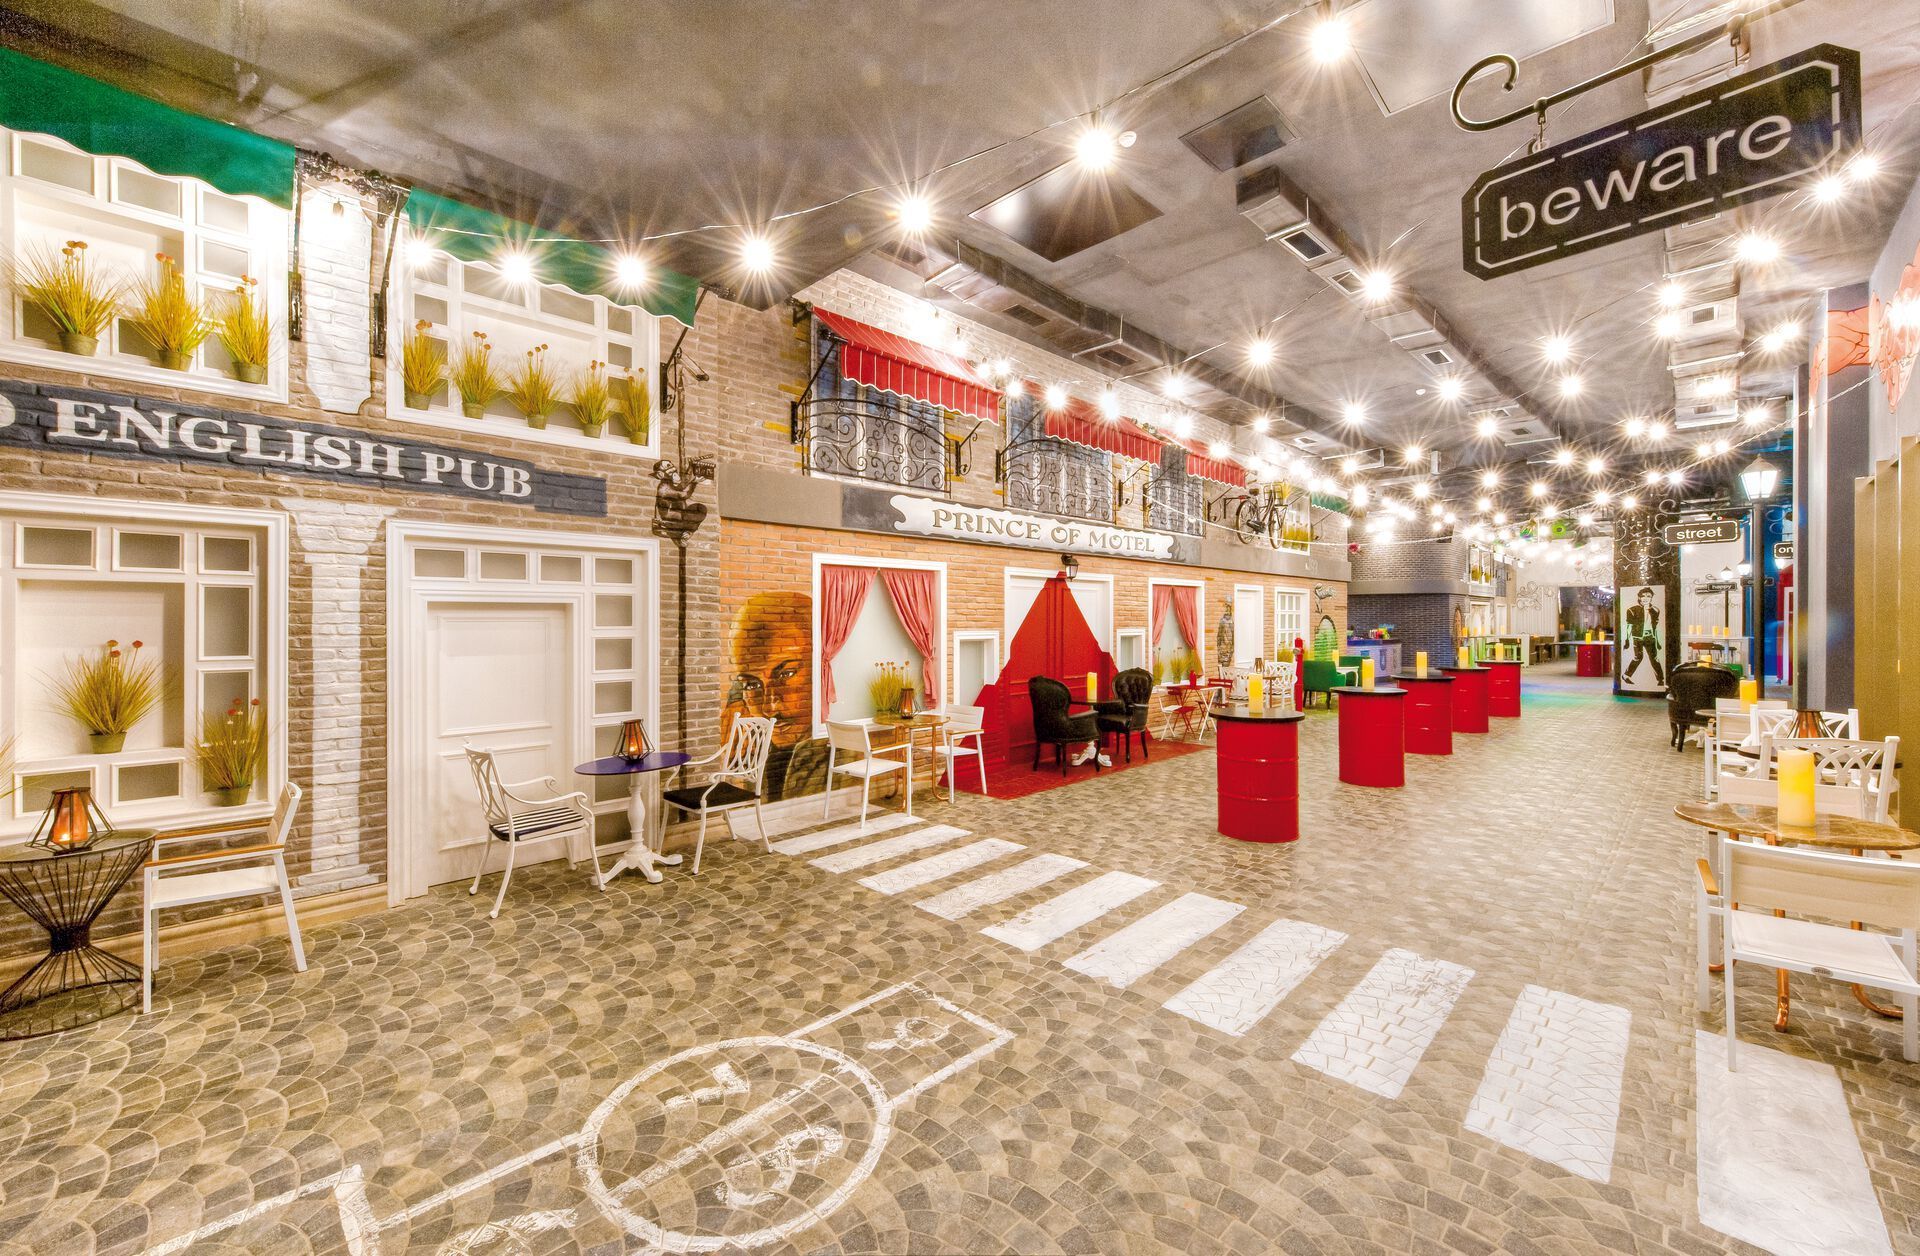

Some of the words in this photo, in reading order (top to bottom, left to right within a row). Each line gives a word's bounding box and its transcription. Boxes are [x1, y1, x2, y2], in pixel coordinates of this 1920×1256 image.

[1500, 115, 1792, 241] beware
[47, 398, 405, 478] ENGLISH
[421, 451, 533, 498] PUB
[932, 508, 1041, 541] PRINCE
[1051, 526, 1081, 546] OF
[1088, 531, 1155, 553] MOTEL
[1676, 527, 1722, 540] street
